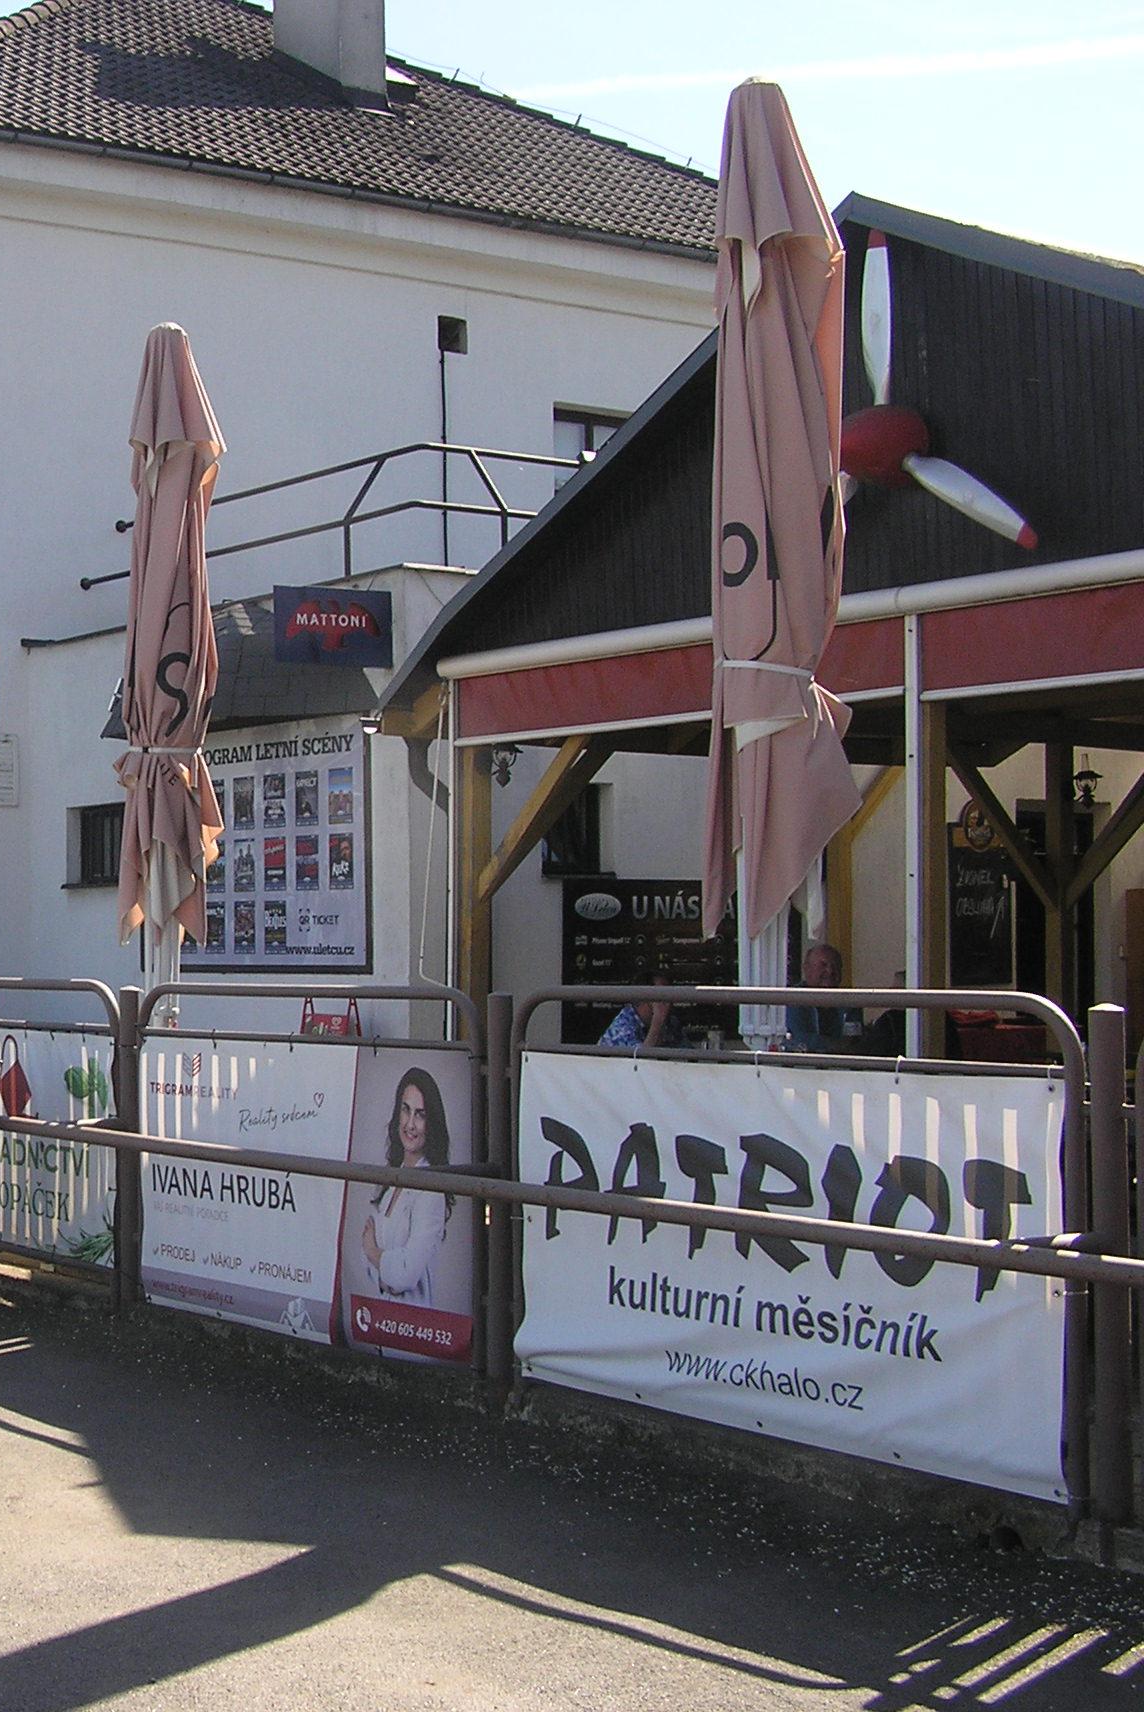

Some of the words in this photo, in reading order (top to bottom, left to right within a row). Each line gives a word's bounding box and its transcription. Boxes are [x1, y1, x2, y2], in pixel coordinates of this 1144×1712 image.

[296, 613, 366, 628] MATTONI
[204, 745, 253, 766] OGRAM
[256, 735, 299, 761] LETNÍ
[302, 731, 354, 756] SCÉNY
[313, 914, 340, 925] TICKET
[632, 895, 648, 919] U
[654, 890, 700, 919] NÁS
[152, 1163, 214, 1201] IVANA
[220, 1171, 297, 1213] HRUBÁ
[540, 1116, 1032, 1303] PATRIOT
[161, 1243, 196, 1263] PRODEJ
[211, 1251, 242, 1270] NÁKUP
[258, 1261, 312, 1284] PRONÁJEM
[375, 1320, 397, 1334] +420
[398, 1322, 415, 1337] 605
[416, 1326, 433, 1341] 449
[434, 1329, 452, 1345] 532
[608, 1266, 744, 1328] kulturní
[755, 1295, 943, 1363] měsíčník
[665, 1350, 865, 1412] www.ckhalo.cz
